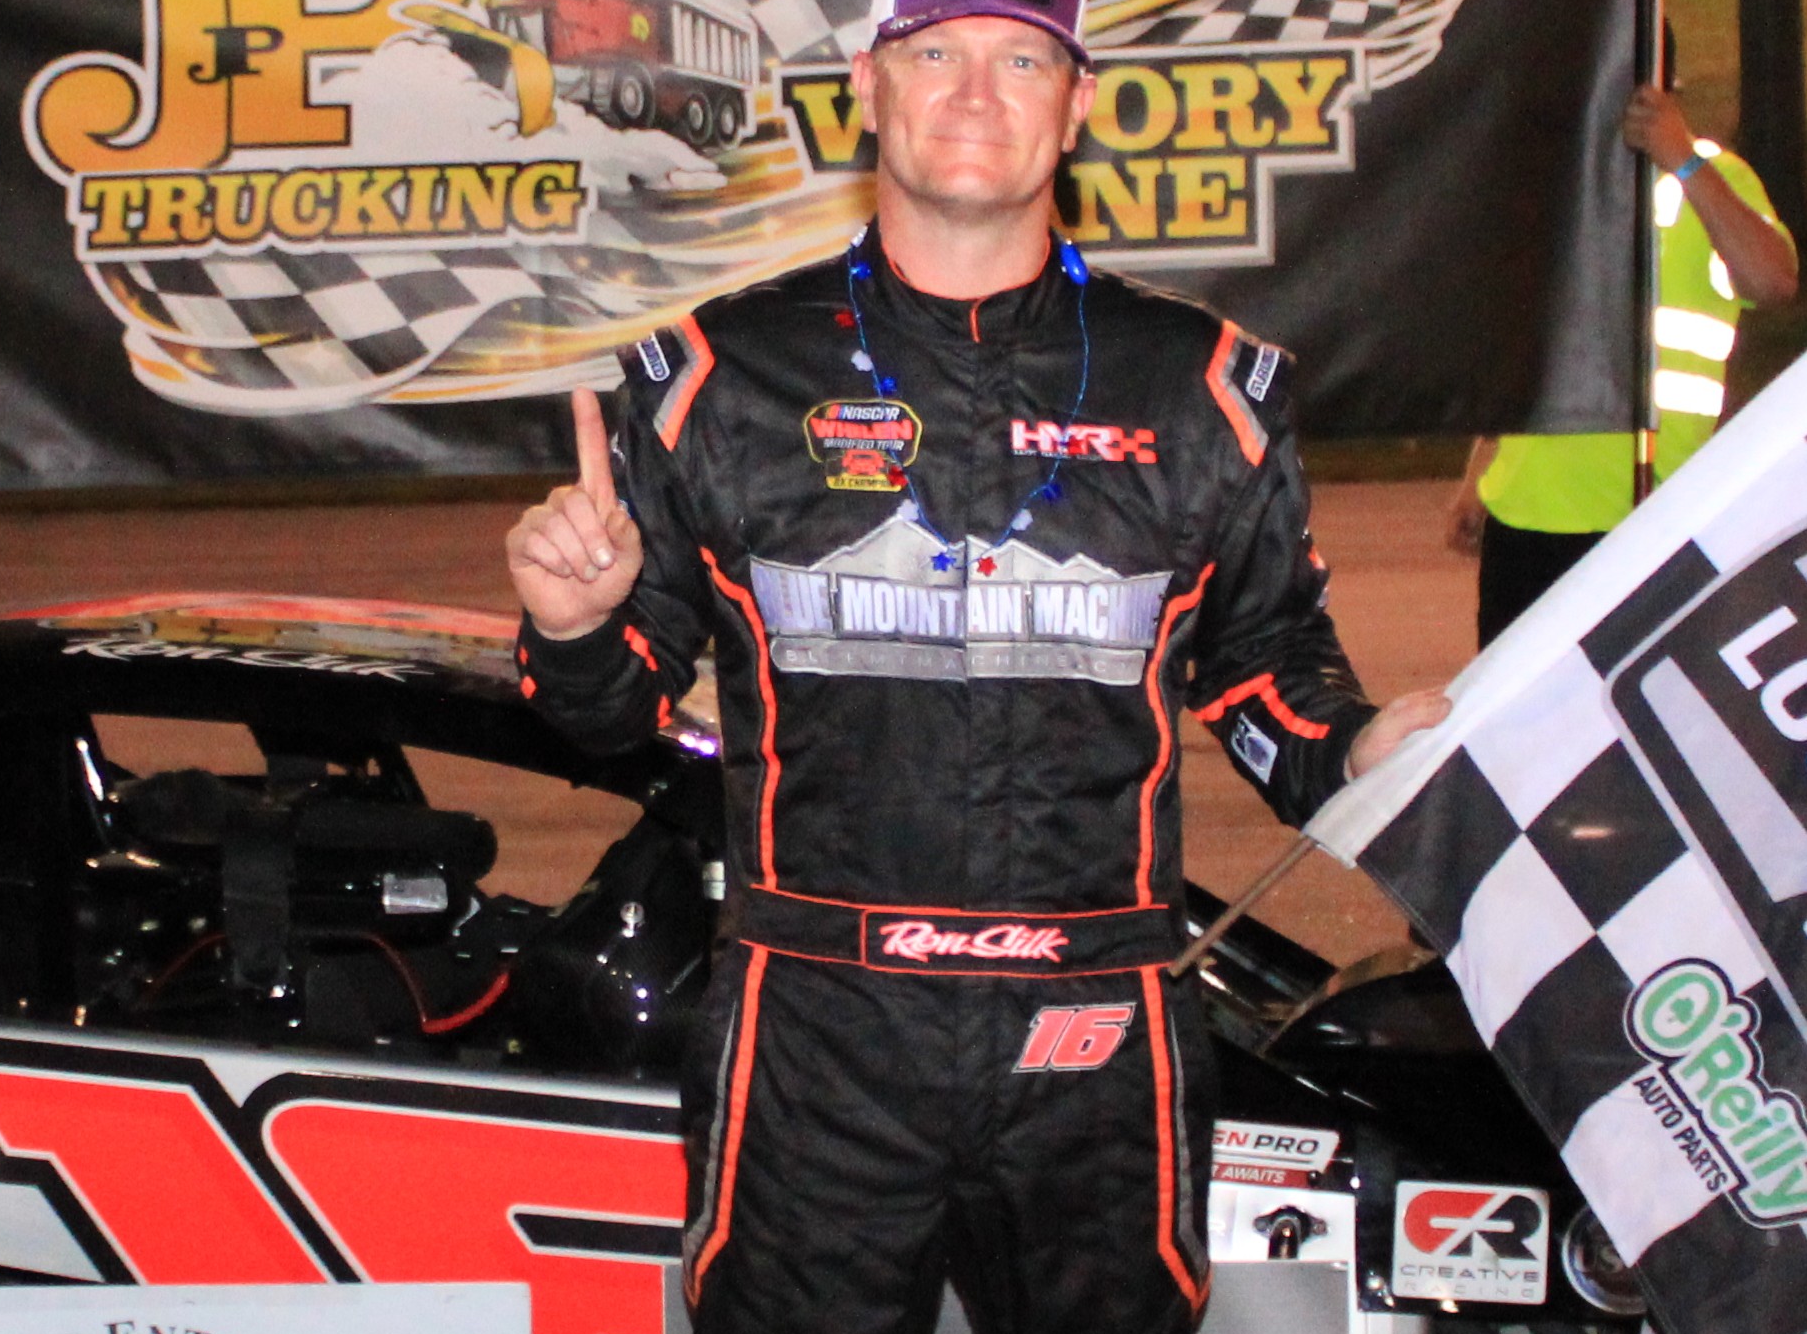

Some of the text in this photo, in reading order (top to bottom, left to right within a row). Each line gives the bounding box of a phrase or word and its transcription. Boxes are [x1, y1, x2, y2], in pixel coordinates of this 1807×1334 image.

[187, 25, 284, 84] JP
[792, 58, 1348, 165] VORY
[80, 161, 582, 249] TRUCKING
[841, 405, 901, 421] NASCAR
[823, 438, 905, 452] MODIFIED TOUR
[755, 566, 1161, 643] LUE MOUNTAIN MACH
[879, 921, 1070, 964] Ron Silk
[1013, 1002, 1137, 1074] 16
[1254, 1134, 1319, 1155] PRO
[1633, 1075, 1729, 1193] AUTO PARTS
[1222, 1165, 1286, 1184] AWAITS
[1400, 1263, 1540, 1283] CREATIVE
[1402, 1279, 1535, 1299] RACING
